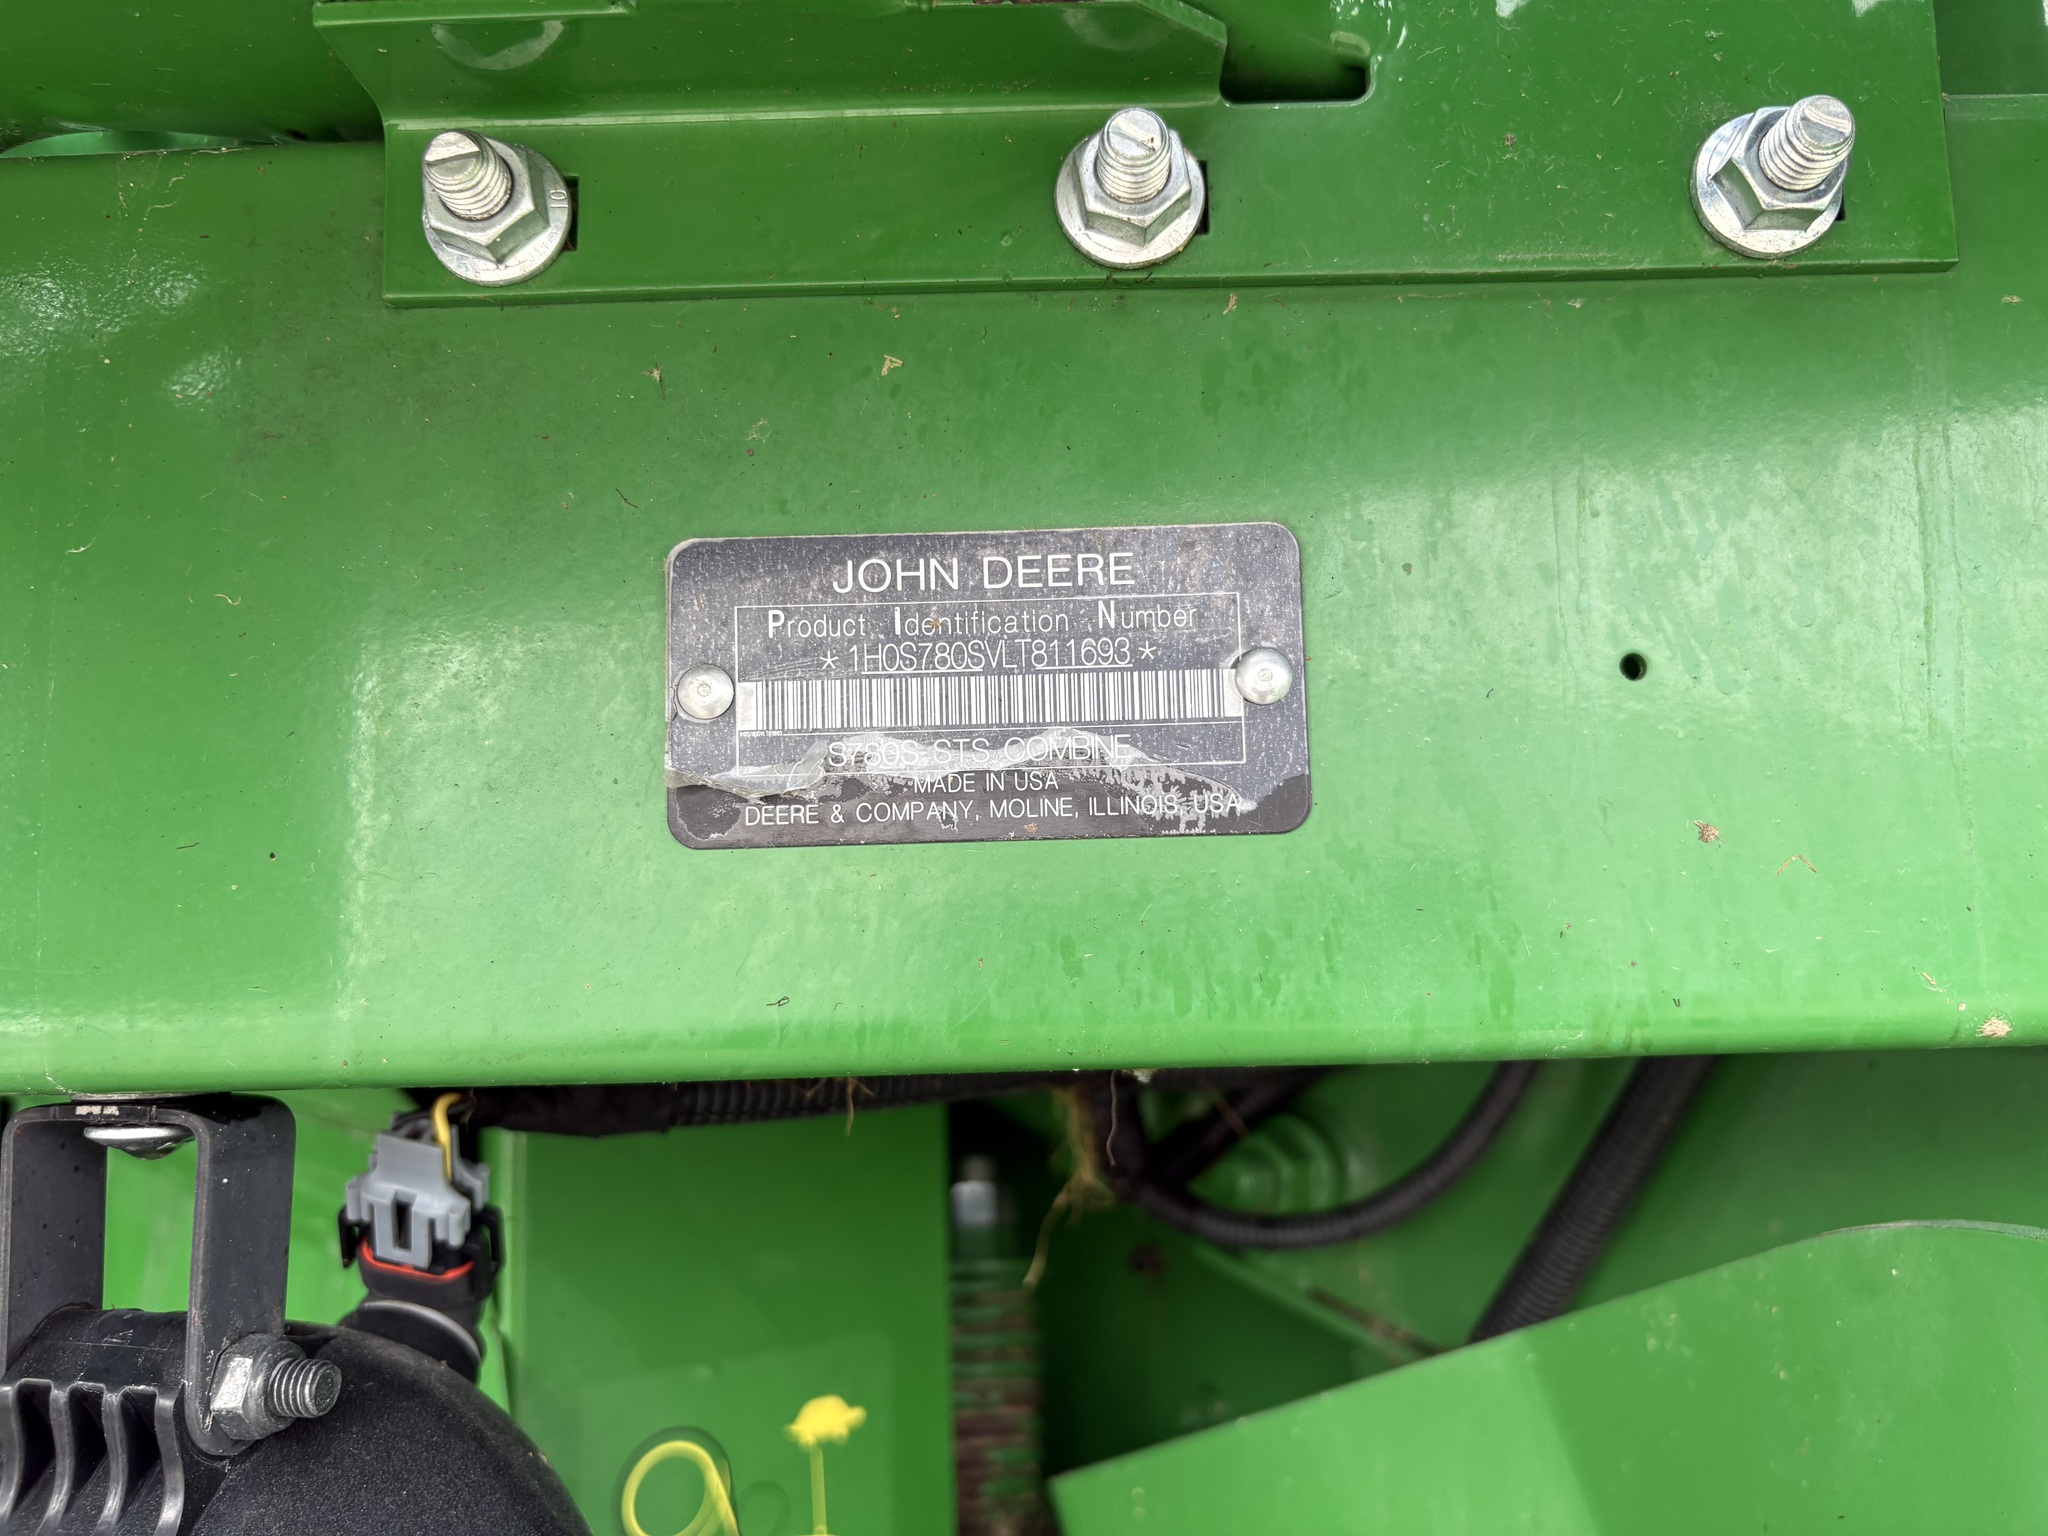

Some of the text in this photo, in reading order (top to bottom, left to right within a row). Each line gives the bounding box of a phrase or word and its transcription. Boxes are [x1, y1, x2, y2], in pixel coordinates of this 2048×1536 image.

[832, 552, 1135, 594] JOHN DEERE
[768, 600, 1197, 638] Product Identification Number
[828, 733, 1131, 767] S780S STS COMBINE
[913, 771, 1059, 794] MADE IN USA
[745, 793, 1242, 826] DEERE & COMPANY, MOLINE, ILLINOIS, USA
